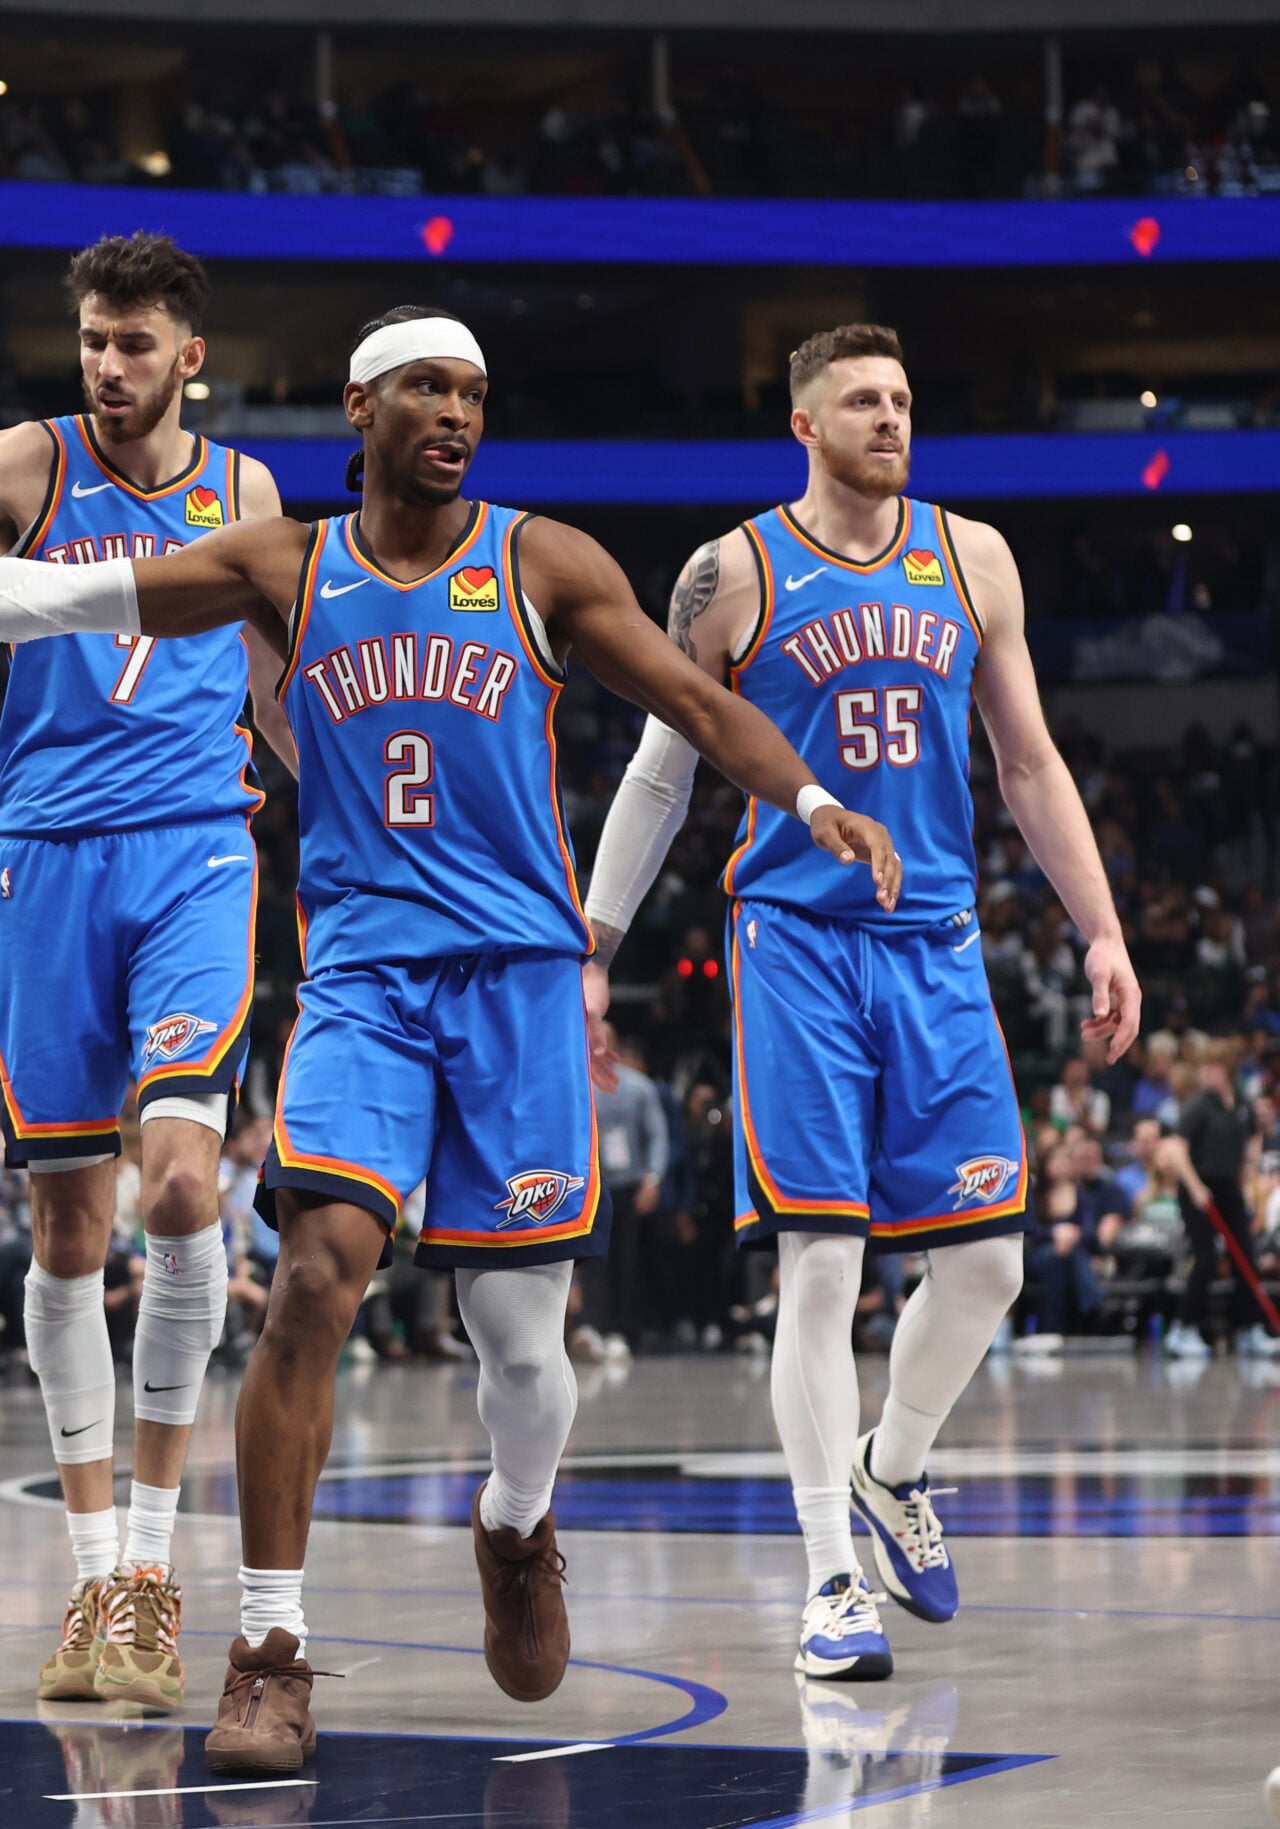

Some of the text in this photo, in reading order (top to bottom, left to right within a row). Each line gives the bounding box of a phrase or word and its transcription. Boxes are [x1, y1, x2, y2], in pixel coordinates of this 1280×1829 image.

[108, 632, 158, 704] 7
[302, 632, 519, 726] THUNDER
[780, 601, 962, 688] THUNDER
[834, 684, 923, 772] 55
[384, 729, 435, 828] 2
[511, 1179, 557, 1216] OKC
